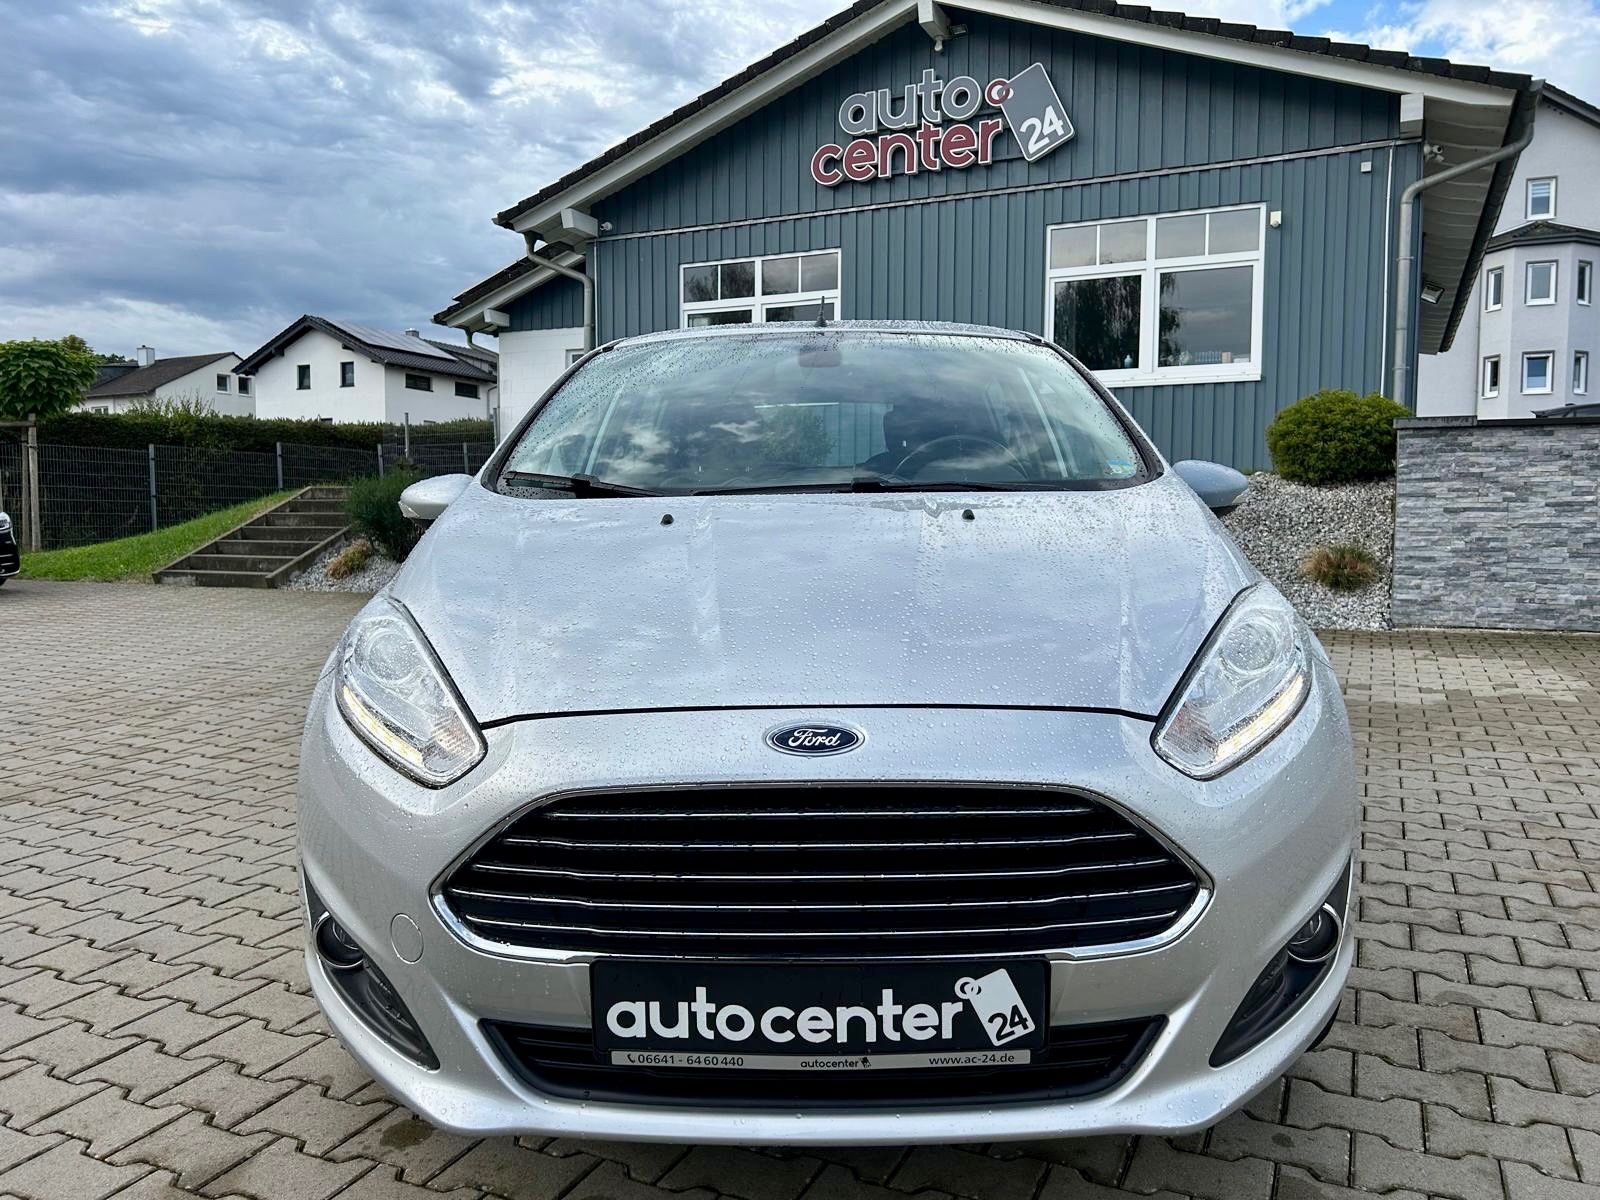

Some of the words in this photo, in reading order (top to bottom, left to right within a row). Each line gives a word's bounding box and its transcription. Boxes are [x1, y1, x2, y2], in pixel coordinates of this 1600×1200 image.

[839, 69, 982, 135] auto
[1020, 105, 1065, 154] 24
[811, 118, 1002, 186] center
[788, 728, 841, 747] Ford
[988, 1004, 1029, 1041] 24
[637, 1054, 675, 1064] 06641
[800, 1059, 858, 1068] autocenter
[929, 1053, 1015, 1065] www.ac-24.de
